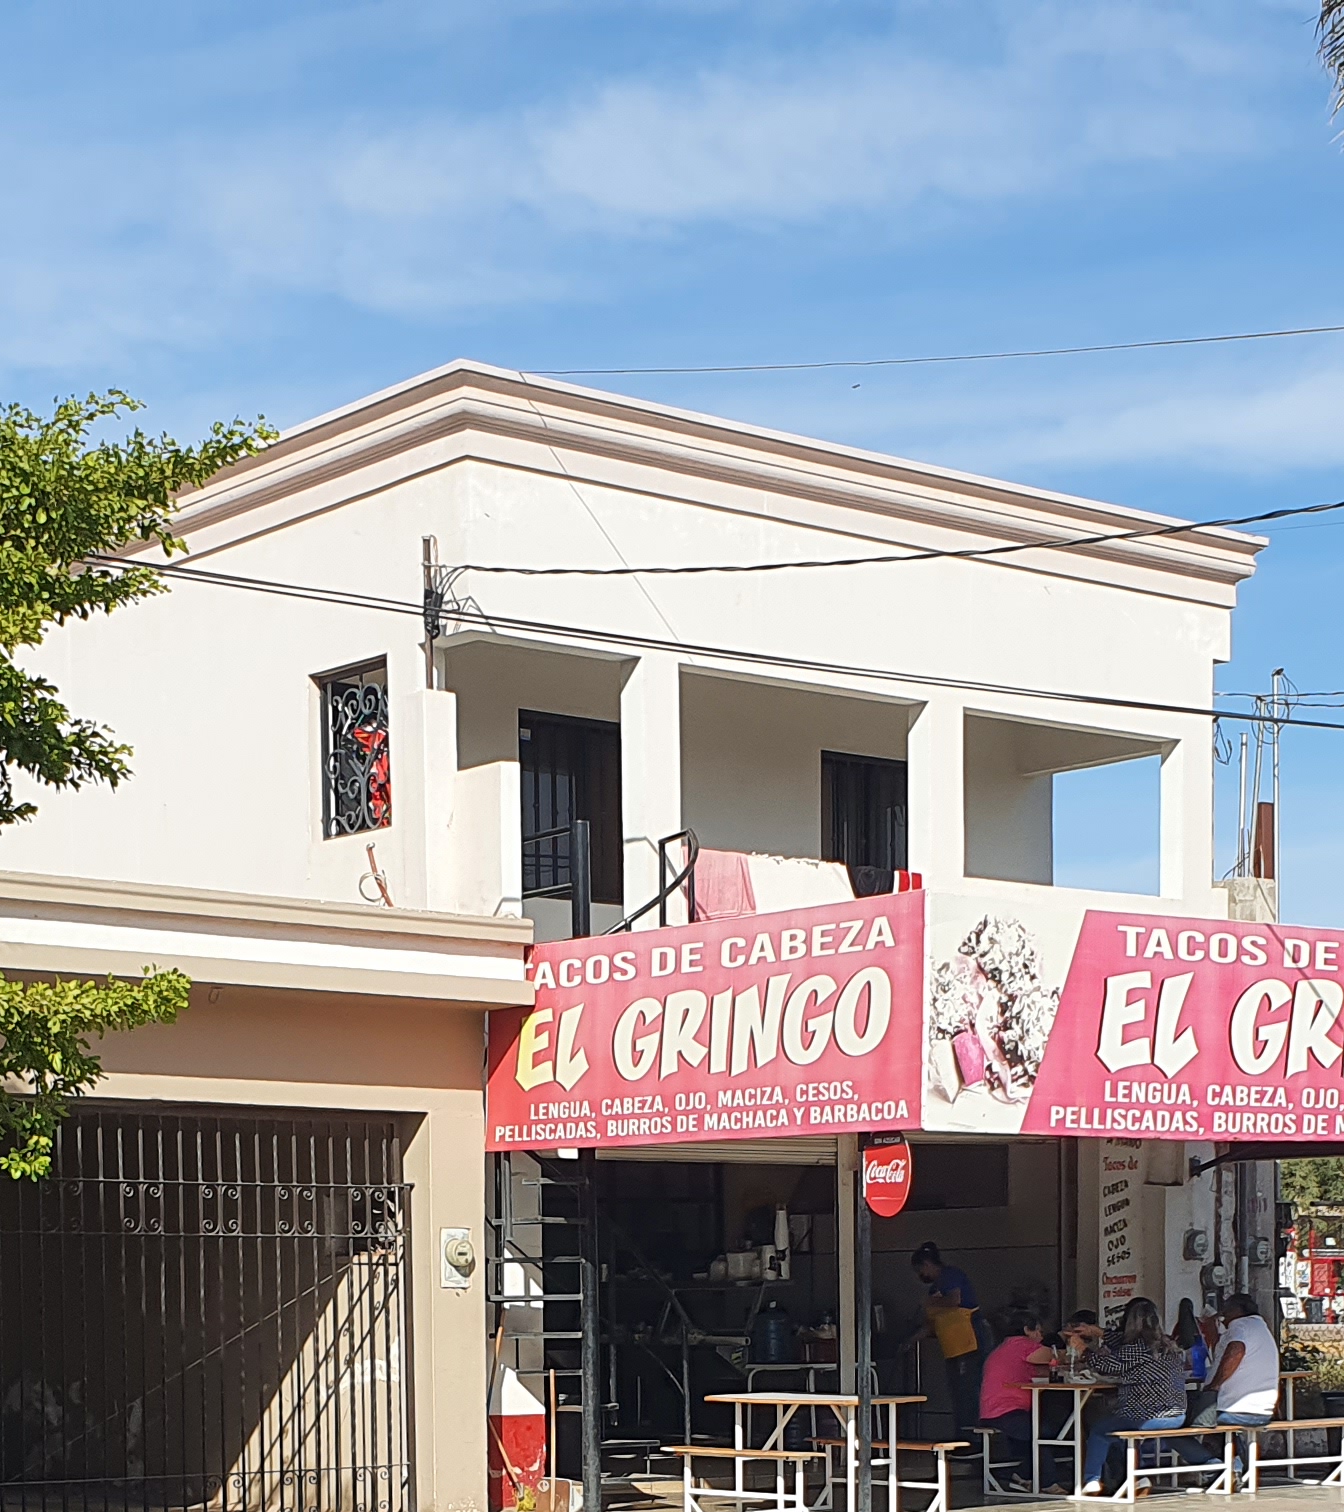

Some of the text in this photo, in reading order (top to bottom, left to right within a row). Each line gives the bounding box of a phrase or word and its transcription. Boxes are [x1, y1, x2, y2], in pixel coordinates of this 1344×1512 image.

[524, 915, 896, 990] ACOS DE CABEZA
[1117, 924, 1268, 966] TACOS
[1283, 938, 1340, 971] DE
[514, 966, 892, 1092] EL GRINGO
[1094, 970, 1199, 1079] EL
[529, 1081, 859, 1120] LENGUA, CABEZA, OJO, MACIZA, CESOS,
[1104, 1080, 1199, 1107] LENGUA,
[1207, 1084, 1294, 1110] CABEZA,
[1301, 1088, 1344, 1112] OJO,
[495, 1099, 909, 1142] PELLISCADAS, BURROS DE MACHACA Y BARBACOA
[1049, 1105, 1205, 1136] PELLISCADAS,
[1212, 1111, 1297, 1134] BURROS
[1302, 1114, 1329, 1135] DE
[1103, 1156, 1126, 1171] Tacos
[1103, 1179, 1129, 1198] CABEZA
[1104, 1198, 1130, 1217] LENGUA
[1104, 1218, 1128, 1237] MACIZA
[1107, 1234, 1126, 1252] OJO
